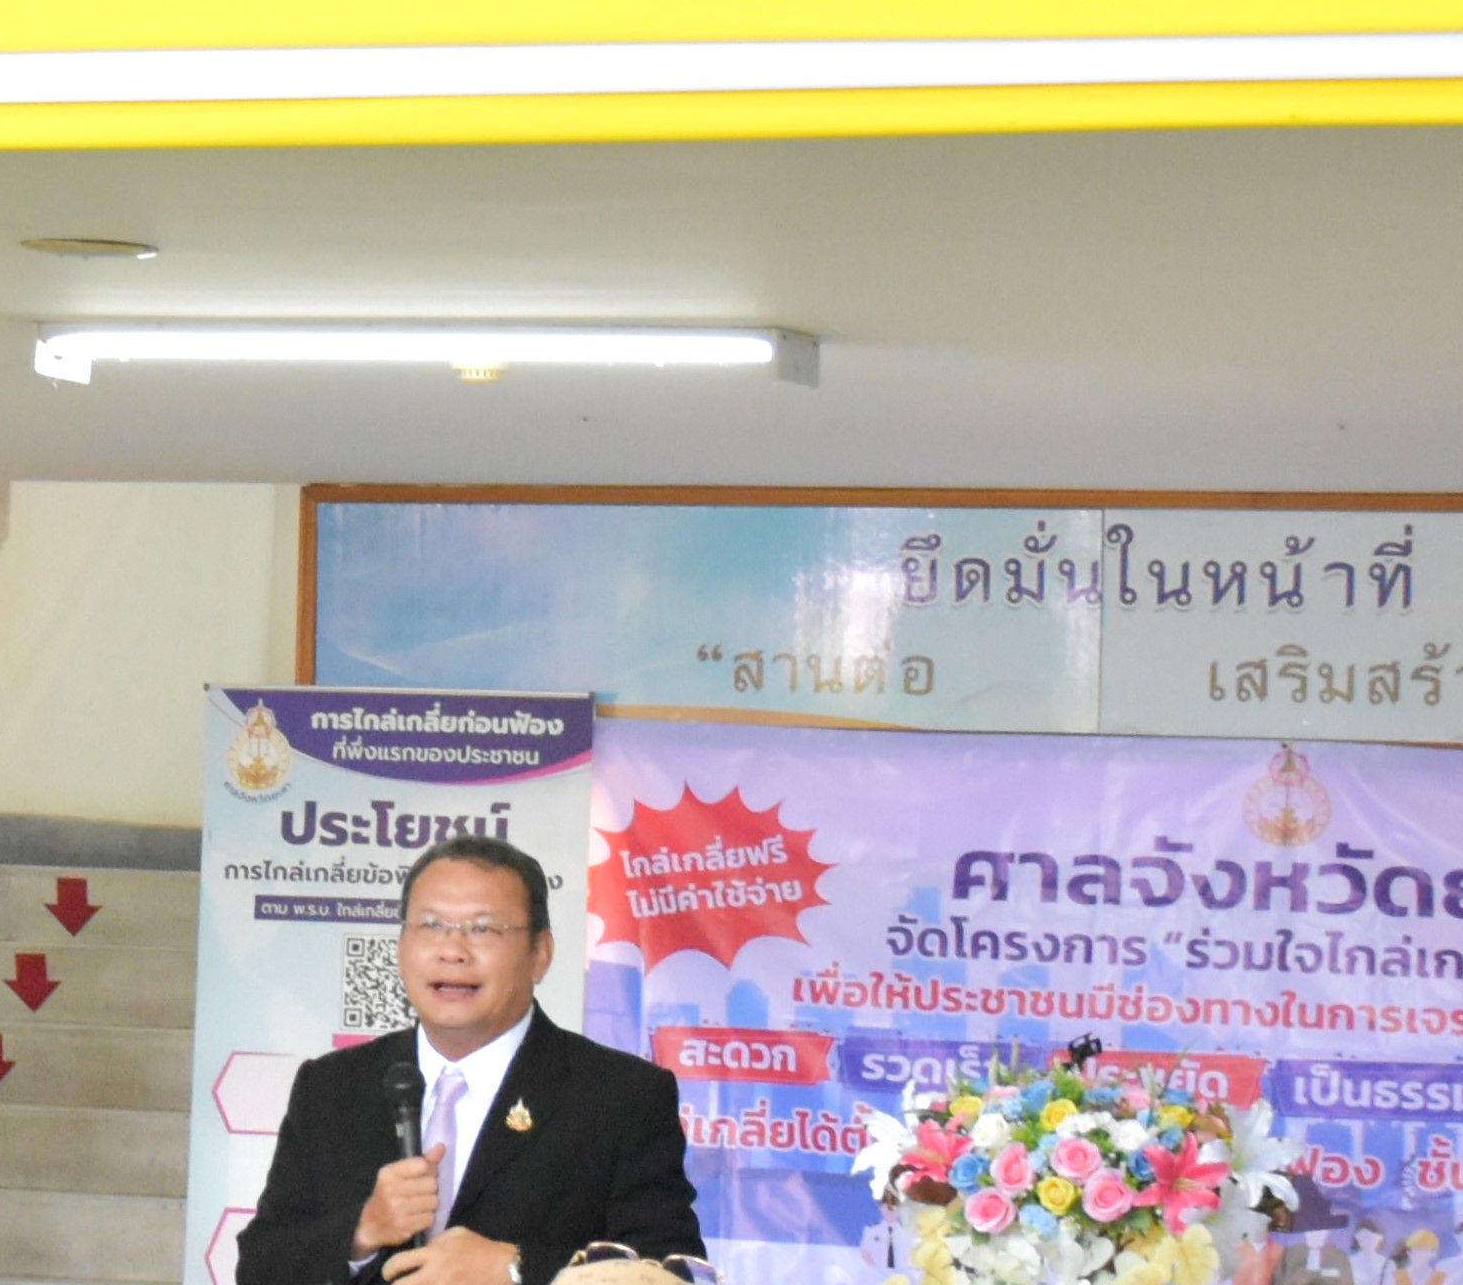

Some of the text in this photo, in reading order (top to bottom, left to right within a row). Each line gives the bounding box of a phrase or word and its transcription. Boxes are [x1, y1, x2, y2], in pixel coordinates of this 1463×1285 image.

[901, 520, 1415, 610] ยึดมั่นในหน้าที่
[696, 641, 936, 697] “สานต่อ
[311, 702, 565, 736] การไกล่เกลี่ยก่อนฟ้อง
[332, 736, 540, 766] ที่พึ่งแรกของประชาชน
[620, 832, 789, 879] ไกล่เกลี่ยฟรี
[260, 902, 288, 916] ตาม
[627, 869, 803, 920] ไม่มีค่าใช้จ่าย
[886, 914, 1148, 967] จัดโครงการ
[677, 1036, 798, 1073] สะดวก
[862, 1044, 983, 1085] รวดเร็
